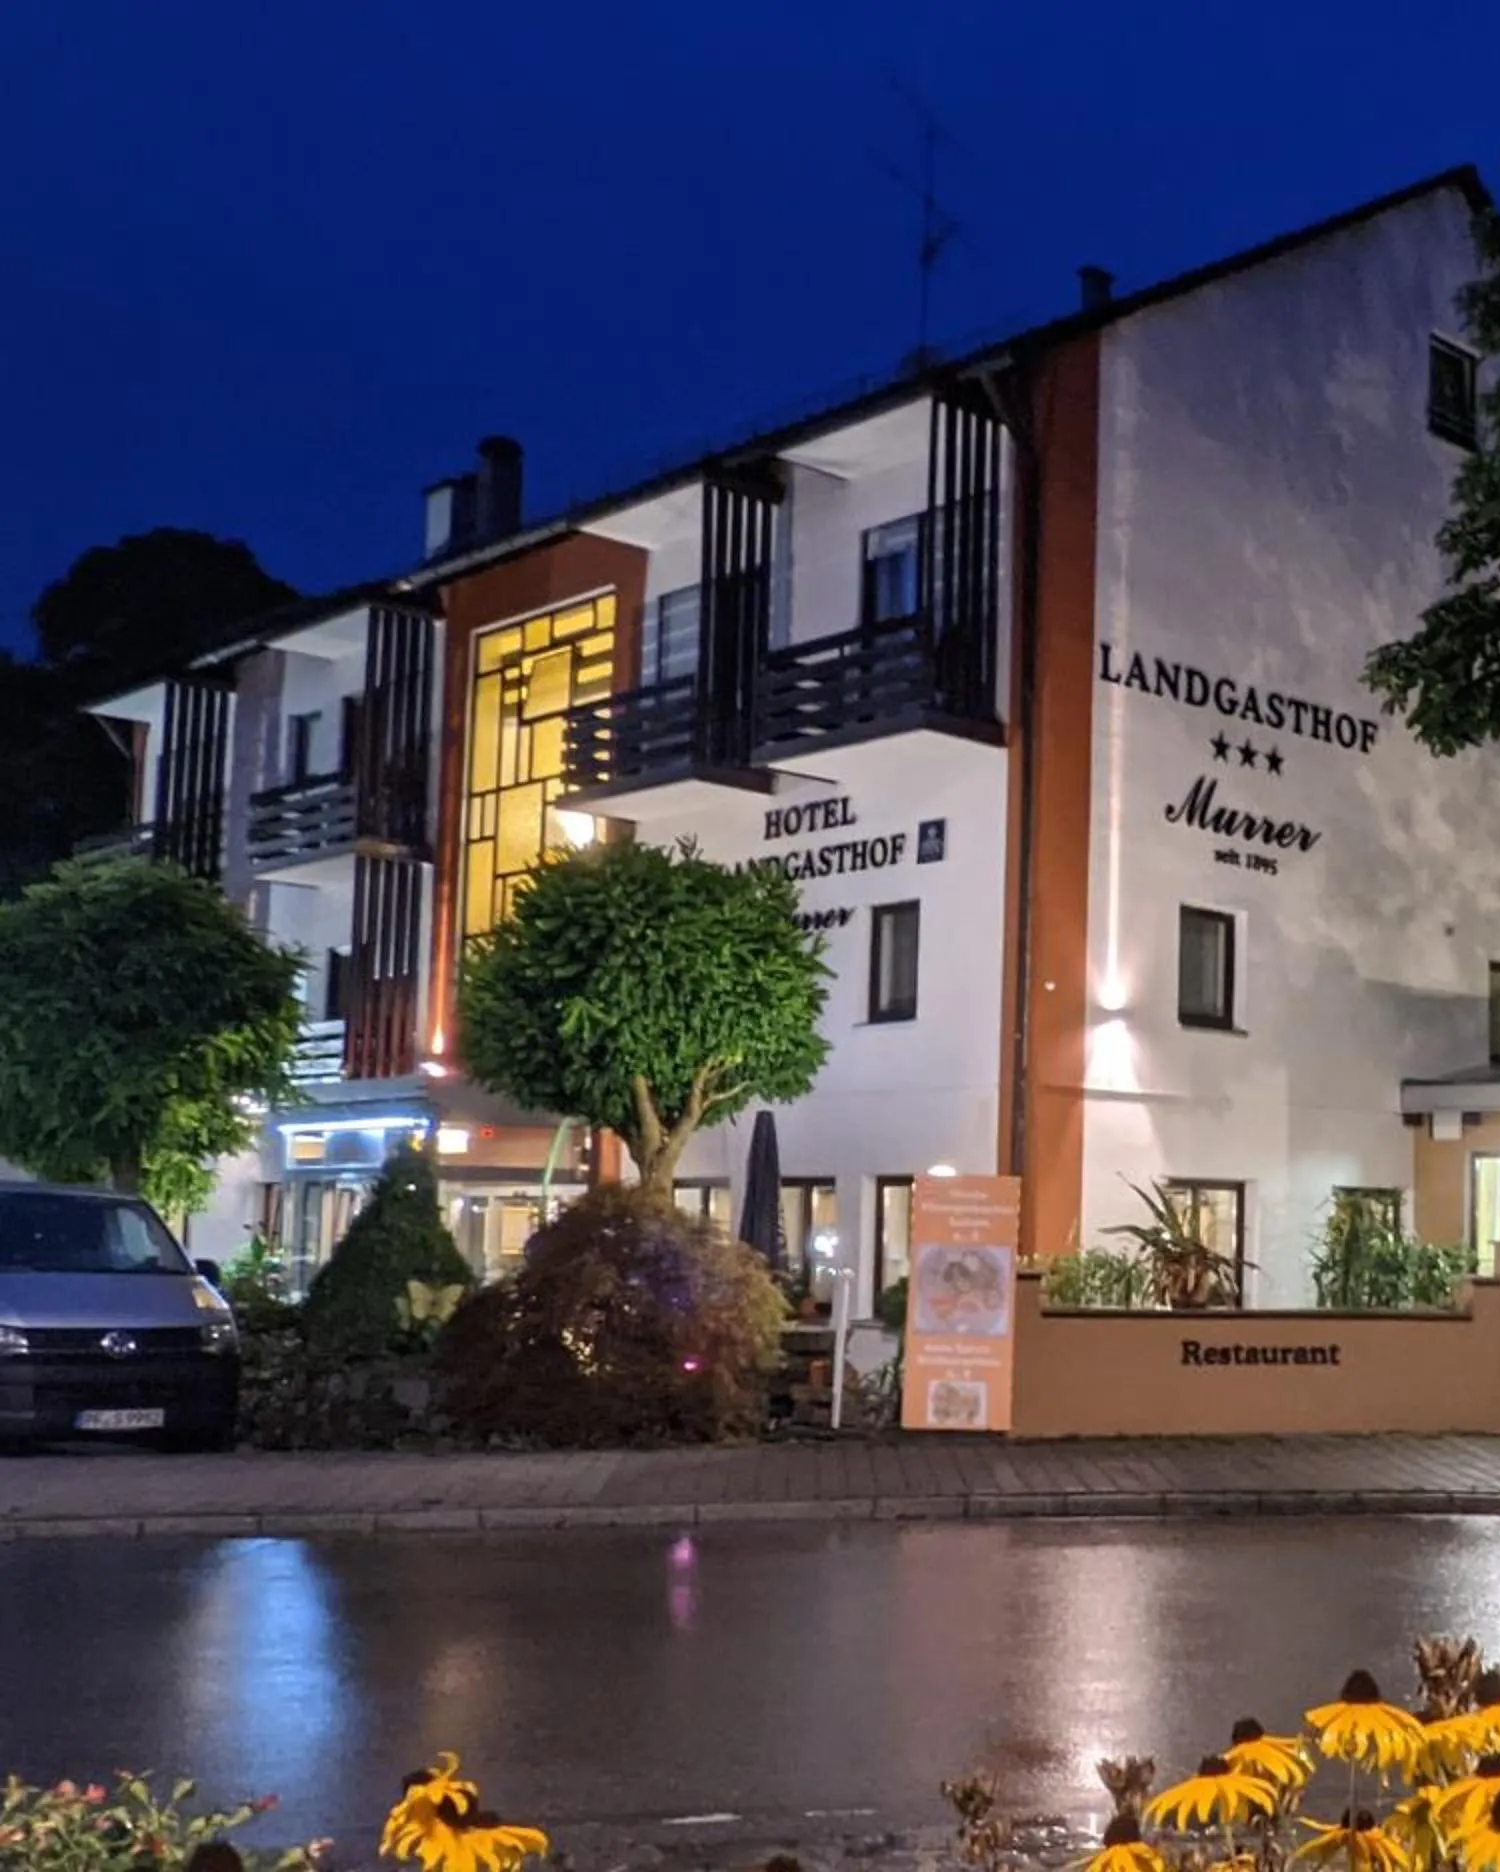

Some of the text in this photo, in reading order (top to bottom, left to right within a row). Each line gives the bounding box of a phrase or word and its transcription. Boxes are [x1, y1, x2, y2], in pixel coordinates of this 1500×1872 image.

[1099, 643, 1378, 752] LANDGASTHOF
[764, 796, 857, 840] HOTEL
[1165, 774, 1322, 852] Murrer
[1181, 1340, 1340, 1366] Restaurant
